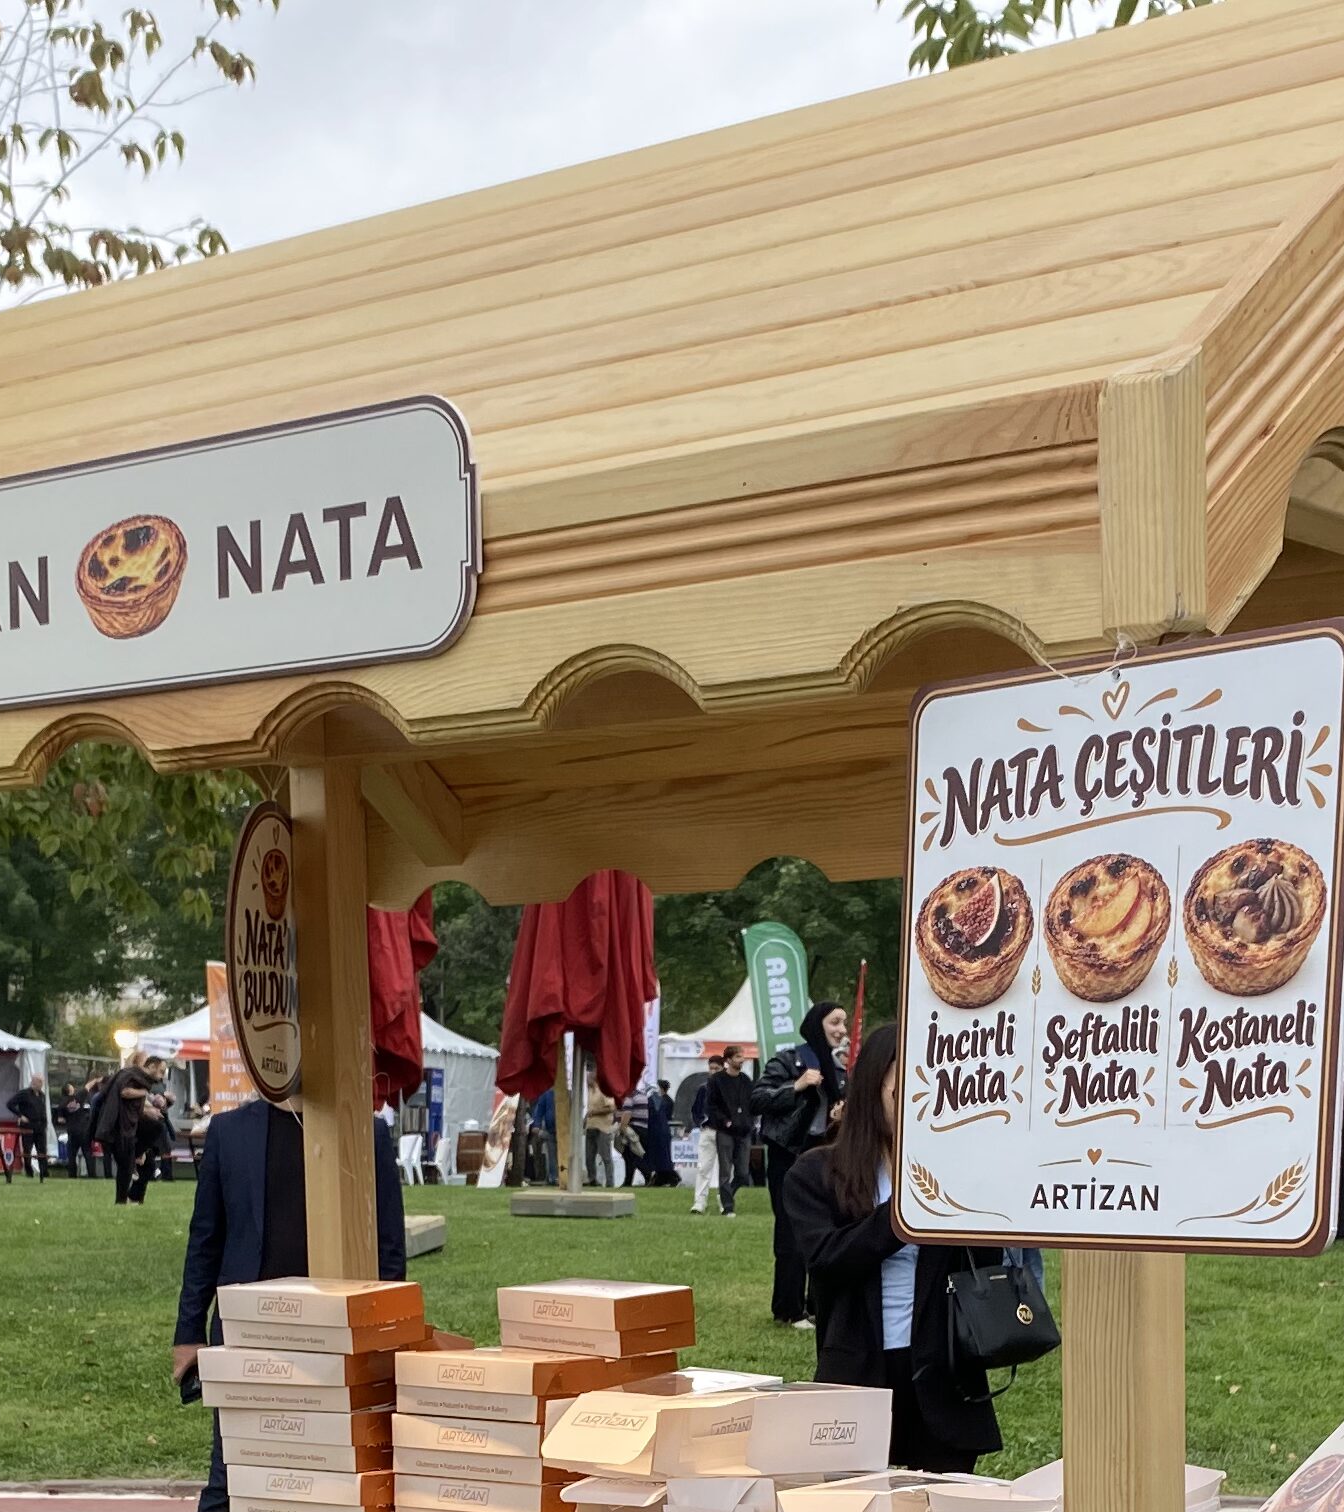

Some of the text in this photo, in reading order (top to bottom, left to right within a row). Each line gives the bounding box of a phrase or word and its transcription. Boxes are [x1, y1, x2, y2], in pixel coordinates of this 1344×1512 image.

[216, 496, 423, 600] NATA
[940, 709, 1307, 849] NATA ÇEŞİTLERİ
[261, 1055, 288, 1076] ARTİZAN
[926, 1010, 1016, 1071] İncirli
[1042, 1004, 1160, 1075] Şeftalili
[1176, 1002, 1317, 1069] Kestaneli
[934, 1062, 1008, 1117] Nata
[1058, 1059, 1140, 1115] Nata
[1199, 1053, 1289, 1116] Nata
[1030, 1176, 1160, 1212] ARTİZAN
[814, 1425, 855, 1441] ARTİZAN
